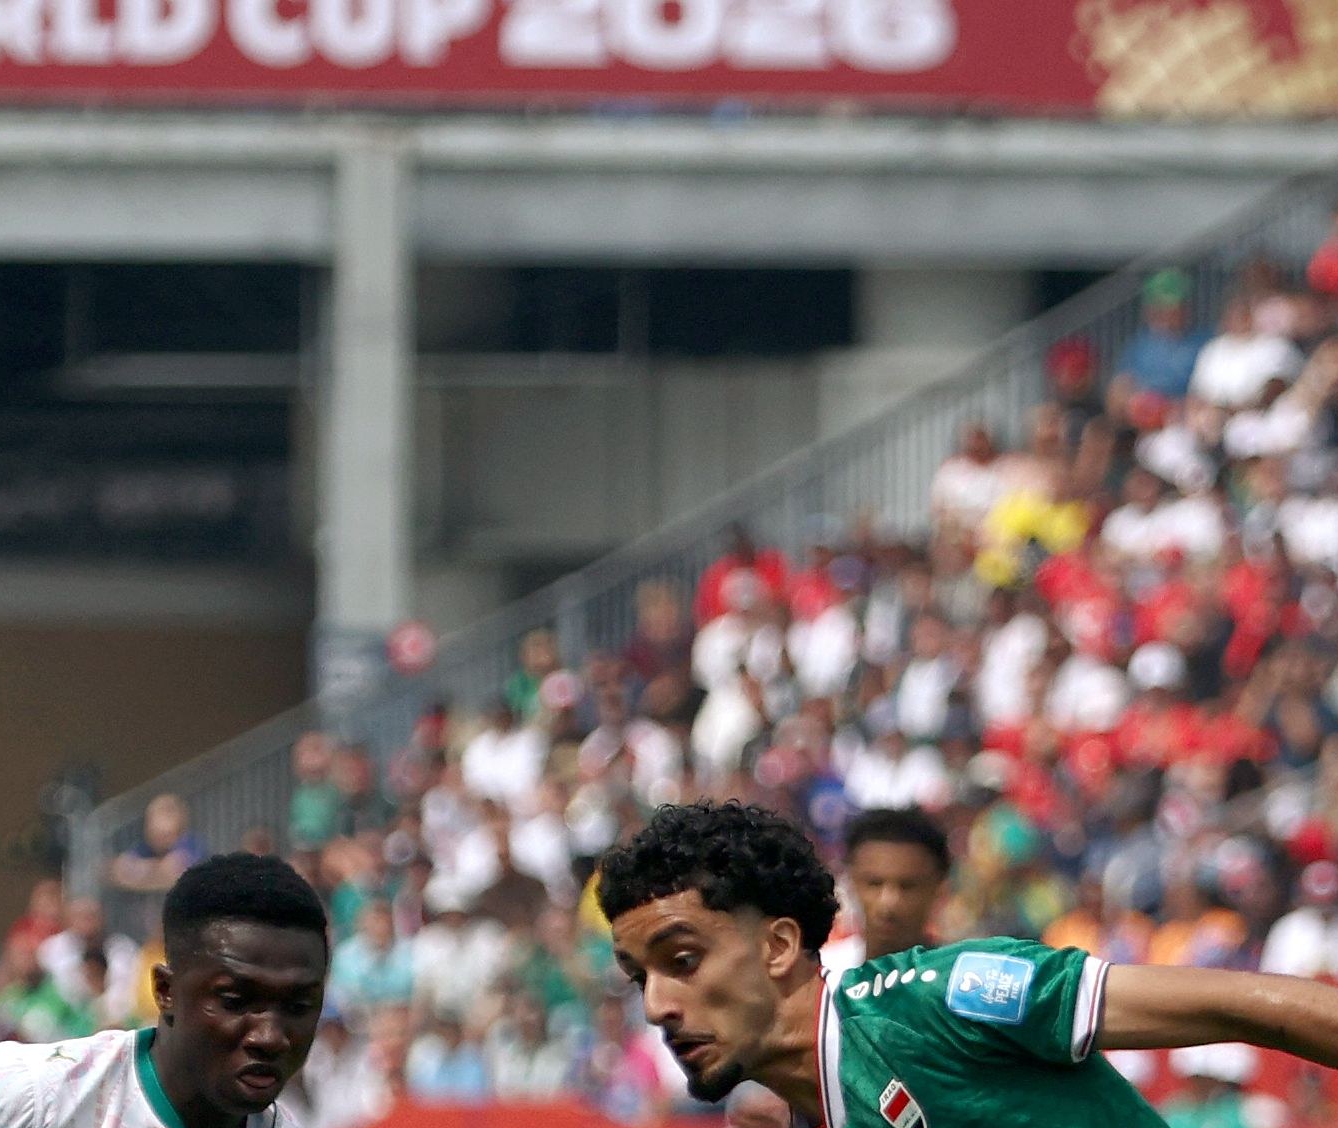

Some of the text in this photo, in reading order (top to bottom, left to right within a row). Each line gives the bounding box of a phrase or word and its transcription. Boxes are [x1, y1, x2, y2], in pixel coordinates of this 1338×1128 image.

[225, 0, 485, 70] CUP
[497, 0, 959, 73] 2026
[994, 973, 1014, 1004] PEACE
[881, 1083, 897, 1104] IRAQ
